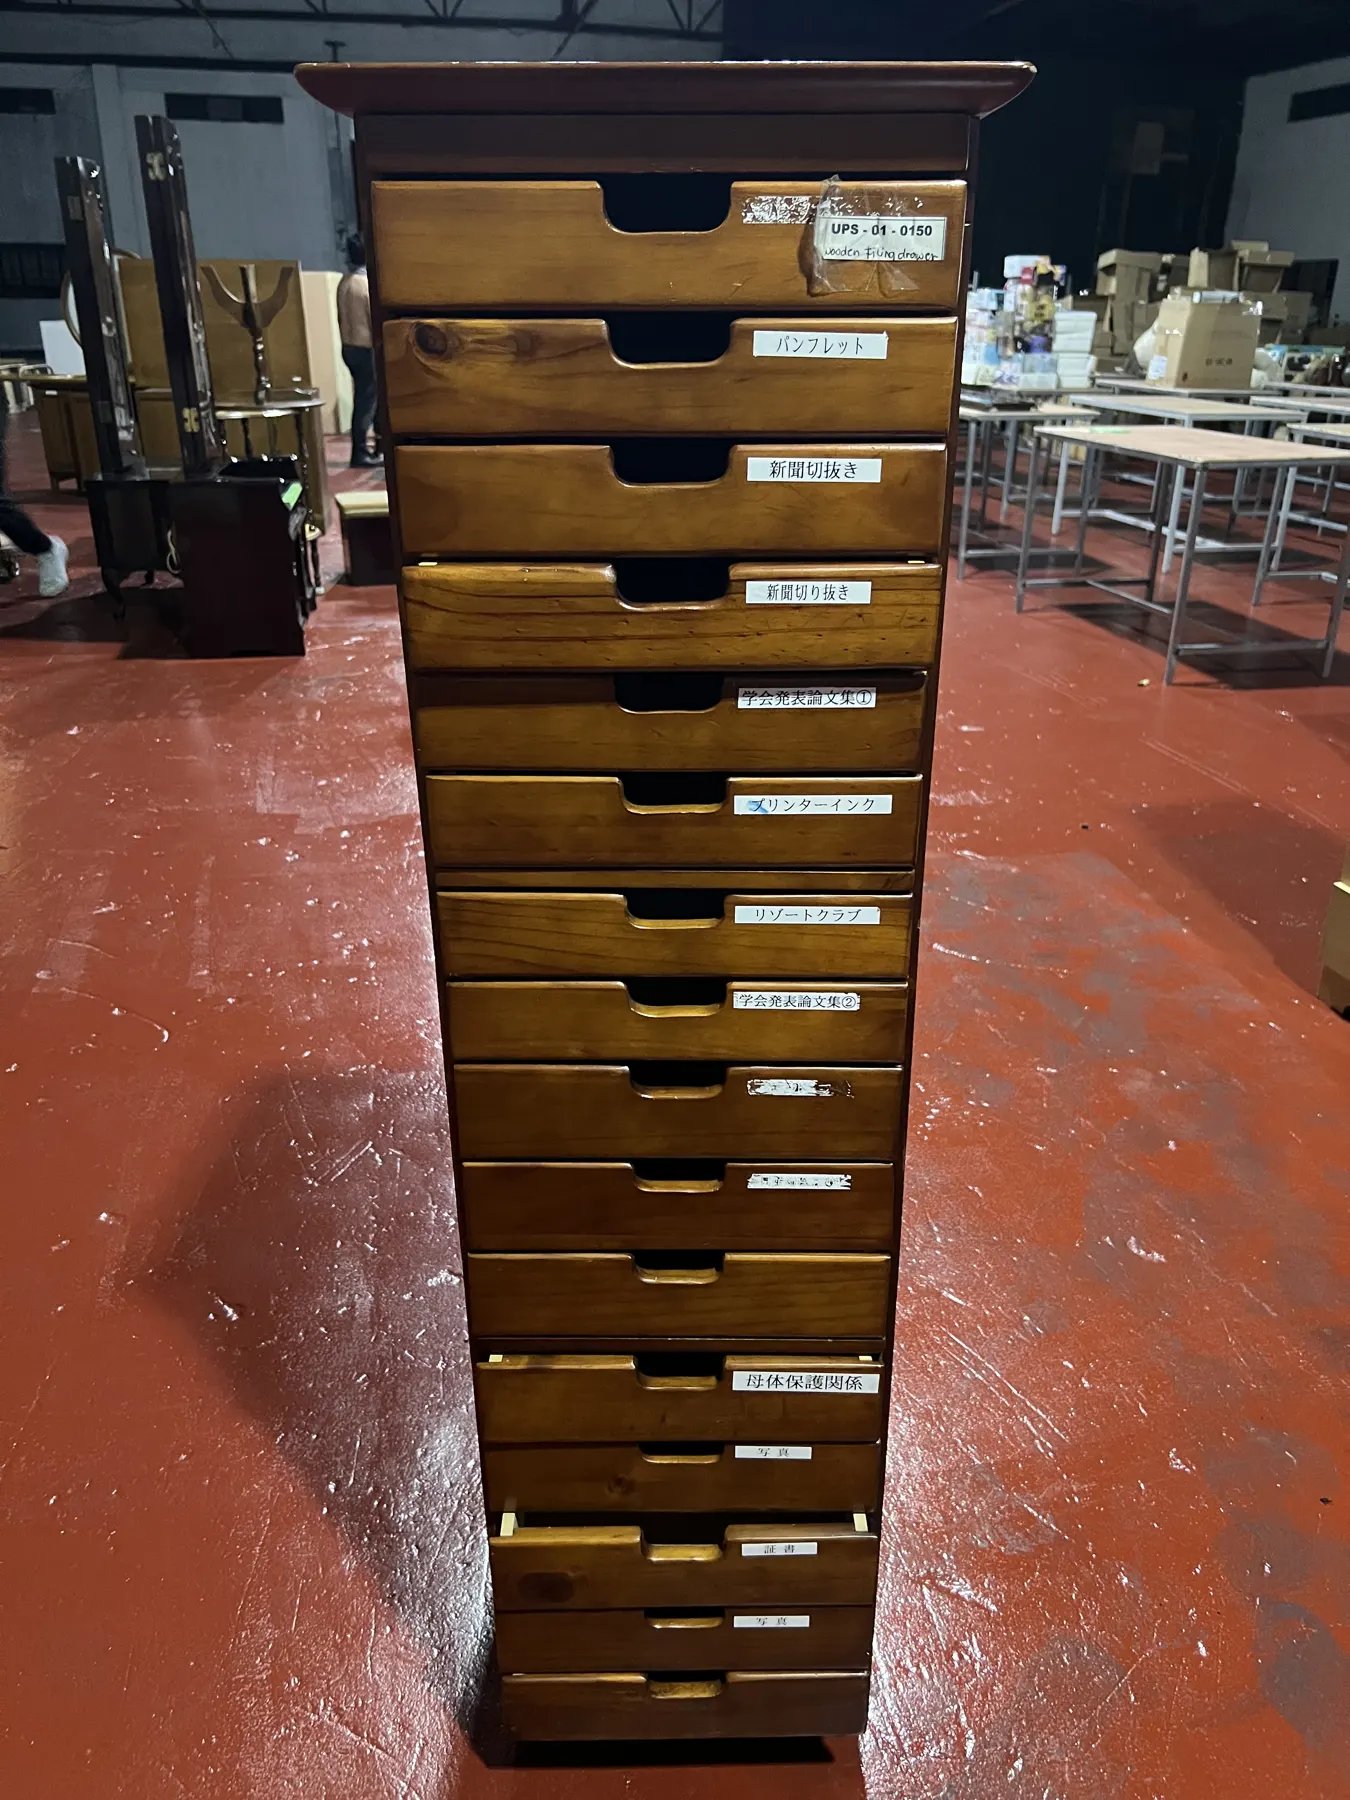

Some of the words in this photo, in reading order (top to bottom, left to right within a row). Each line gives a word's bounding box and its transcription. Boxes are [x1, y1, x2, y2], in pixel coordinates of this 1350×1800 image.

[831, 223, 859, 235] UPS
[871, 225, 887, 236] 01
[900, 225, 933, 237] 0150
[897, 248, 939, 261] drawer
[776, 336, 863, 355] パンフレット
[769, 460, 858, 479] 新聞切抜き
[766, 584, 849, 601] 新聞切り抜き
[741, 689, 873, 707] 学会発表論文集①
[752, 797, 875, 812] プリンターインク
[755, 908, 862, 922] リゾートクラブ
[738, 994, 856, 1009] 学会発表論文集②
[746, 1374, 863, 1391] 母体保護関係
